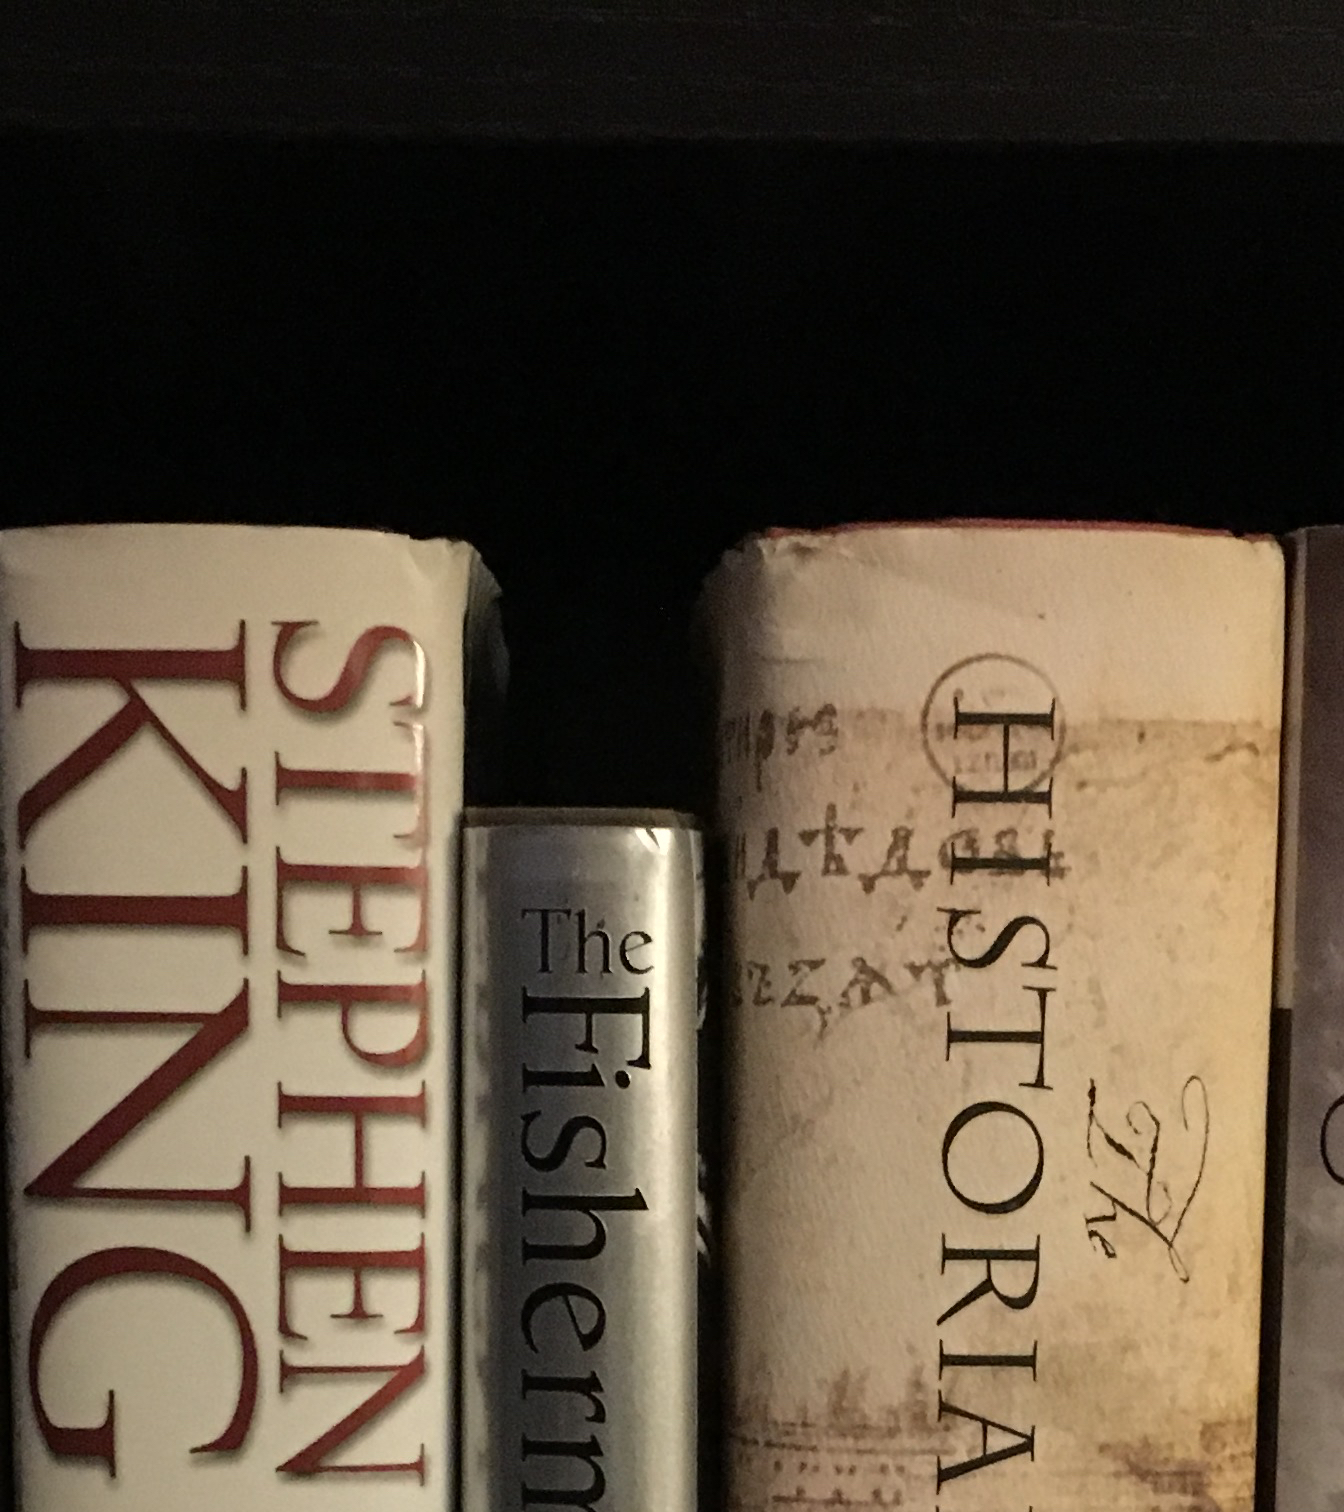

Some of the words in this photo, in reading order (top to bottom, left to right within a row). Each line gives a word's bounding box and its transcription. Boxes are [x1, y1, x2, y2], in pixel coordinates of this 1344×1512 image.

[15, 619, 258, 1479] KING
[270, 619, 432, 1487] STEPHEN
[521, 907, 654, 976] The
[1083, 1074, 1210, 1284] The
